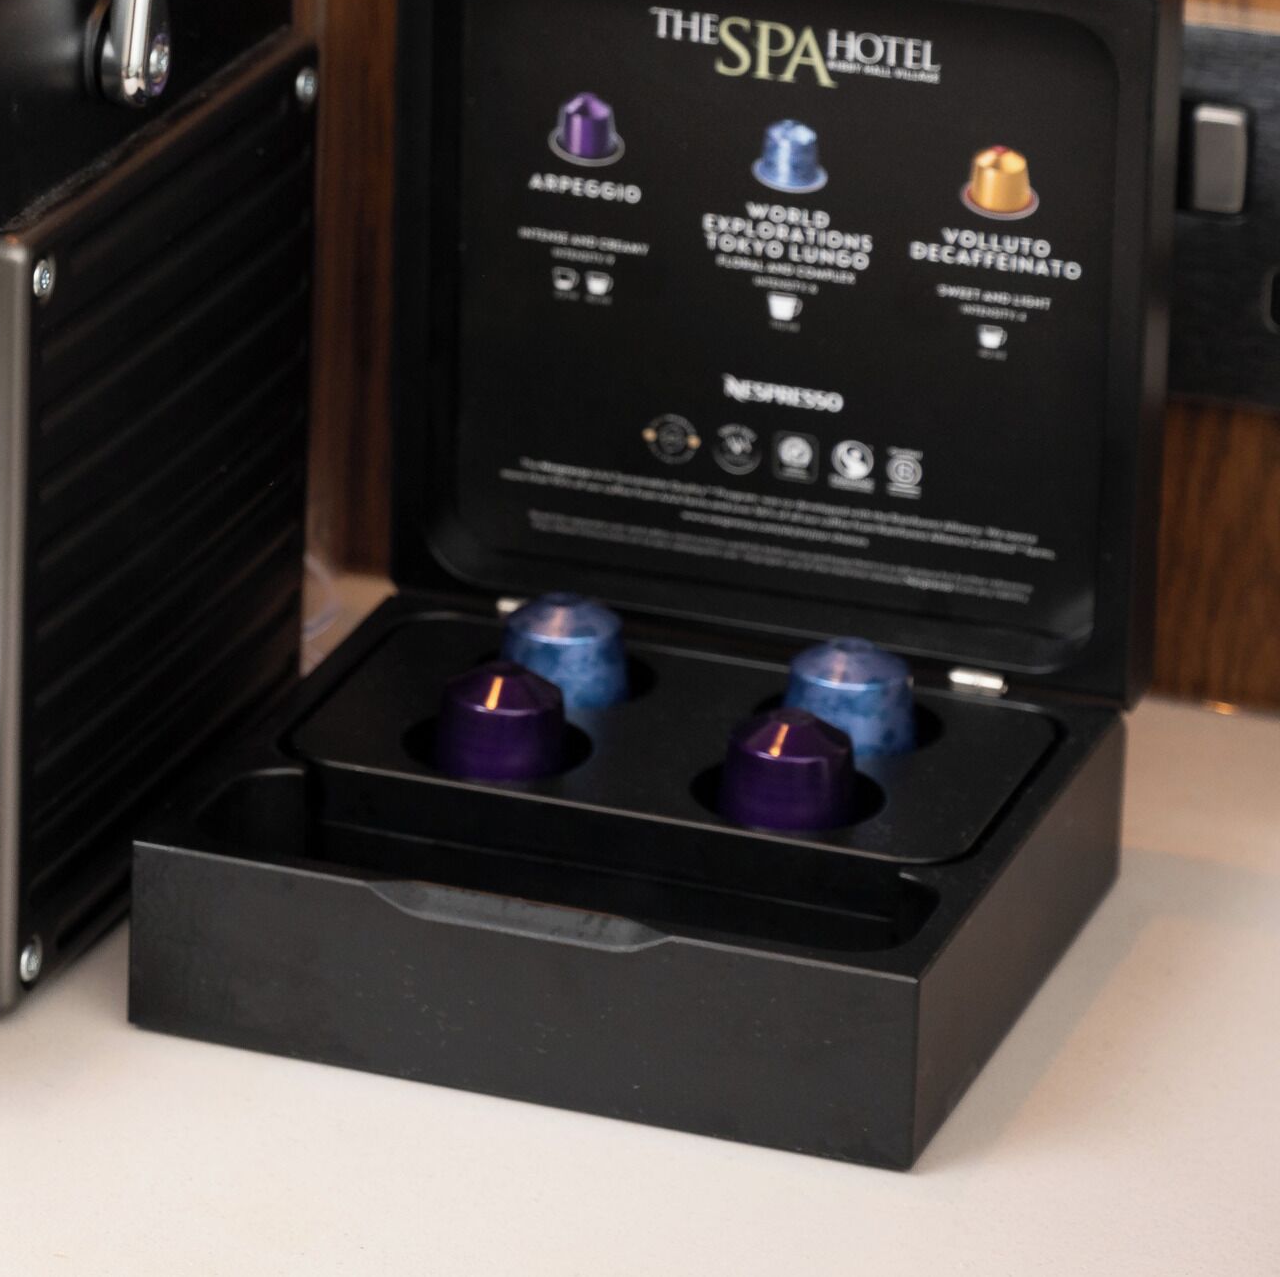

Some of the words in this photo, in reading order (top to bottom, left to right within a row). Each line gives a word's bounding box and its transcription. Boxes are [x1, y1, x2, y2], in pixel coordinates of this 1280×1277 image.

[648, 5, 719, 45] THE
[714, 15, 838, 89] SPA
[826, 28, 942, 72] HOTEL
[528, 172, 642, 205] ARPEGGIO
[702, 212, 873, 254] EXPLORATIONS
[745, 201, 831, 230] WORLD
[705, 230, 784, 260] TOKYO
[788, 242, 870, 271] LUNGO
[909, 240, 1083, 281] DECAFFEINATO
[941, 226, 1052, 259] VOLLUTO
[722, 373, 844, 413] NESPRESSO
